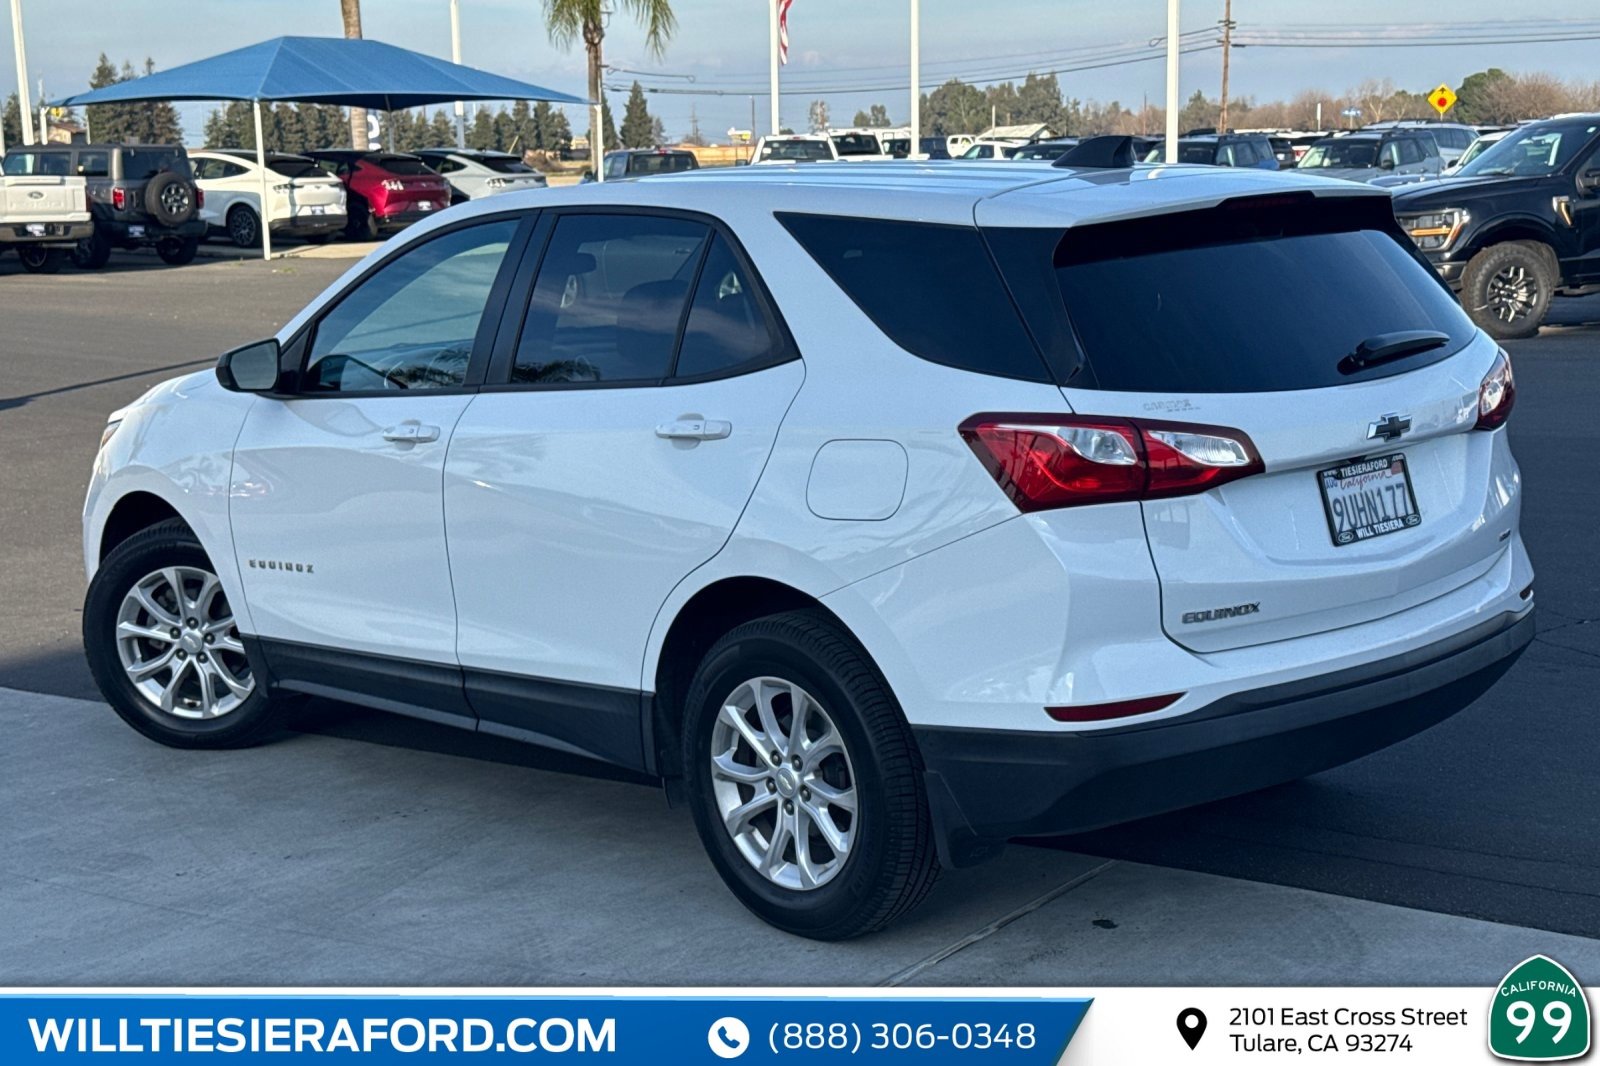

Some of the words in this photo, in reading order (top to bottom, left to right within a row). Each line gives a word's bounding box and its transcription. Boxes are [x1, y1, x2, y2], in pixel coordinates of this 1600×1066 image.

[1340, 459, 1388, 478] TIESIERAFORD
[1332, 483, 1409, 534] 9UHN177
[1356, 525, 1374, 539] WILL
[1373, 518, 1404, 535] TIESIERA
[247, 559, 314, 573] EQUINOX
[1182, 602, 1260, 624] EQUINOX
